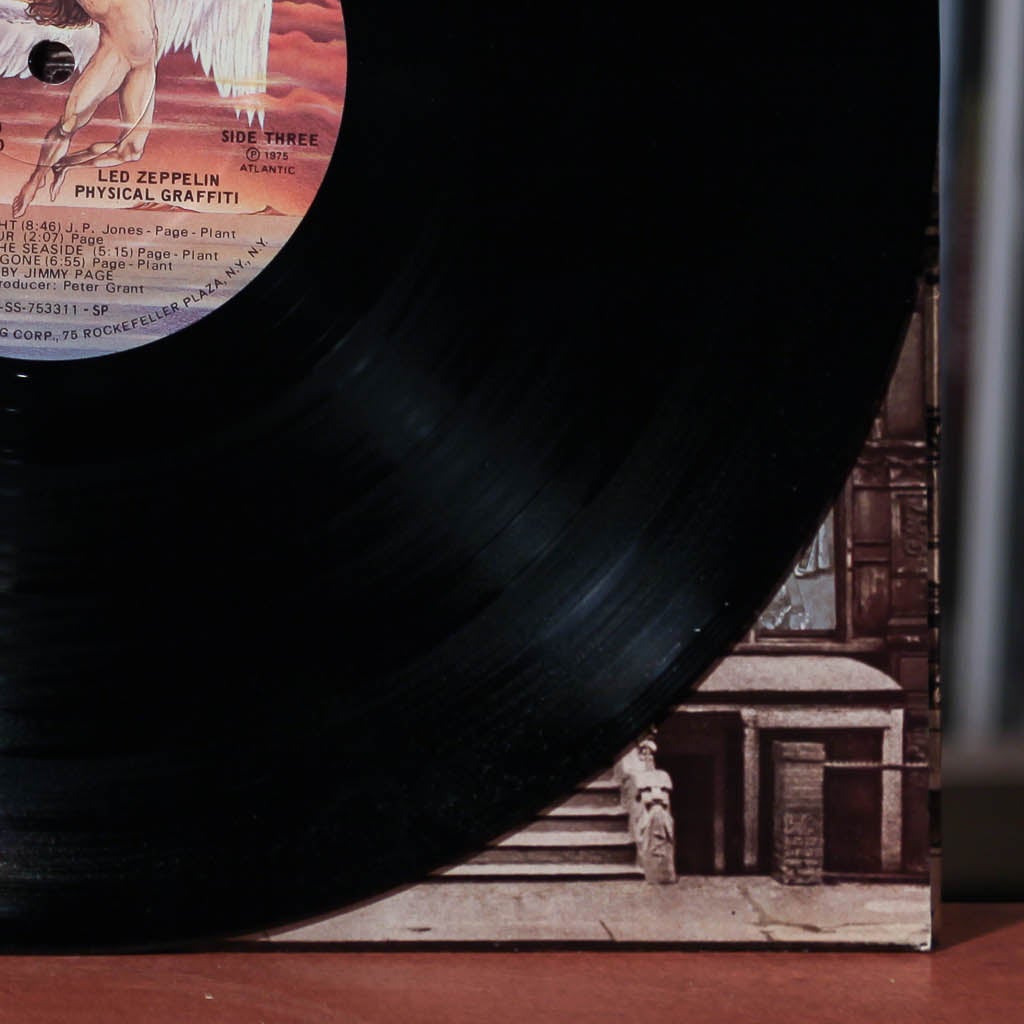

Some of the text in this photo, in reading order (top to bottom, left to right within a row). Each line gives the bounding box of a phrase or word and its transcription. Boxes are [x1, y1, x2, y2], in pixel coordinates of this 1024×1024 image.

[221, 130, 319, 147] SIDE THREE
[264, 151, 289, 161] 1975
[239, 163, 296, 175] ATLANTIC
[97, 169, 220, 187] LED ZEPPELIN
[74, 185, 239, 204] PHYSICAL GRAFFITI
[21, 219, 61, 233] (8:46)
[65, 222, 78, 233] J.
[82, 223, 95, 234] P.
[102, 224, 143, 236] Jones
[155, 225, 188, 239] Page
[200, 227, 236, 239] Plant
[23, 231, 64, 244] (2:07)
[71, 234, 104, 246] Page
[22, 243, 83, 256] SEASIDE
[93, 246, 133, 258] (5:15)
[137, 247, 170, 261] Page
[182, 249, 218, 261] Plant
[0, 253, 41, 266] GONE
[45, 255, 85, 268] (6:55)
[92, 257, 125, 270] Page
[137, 259, 173, 271] Plant
[1, 266, 18, 277] BY
[23, 268, 69, 279] JIMMY
[75, 269, 114, 281] PAGE
[62, 330, 78, 341] 75
[83, 302, 180, 339] ROCKEFELLER
[183, 278, 227, 308] PLAZA,
[247, 237, 269, 258] N.Y.
[63, 280, 100, 292] Peter
[106, 283, 144, 294] Grant
